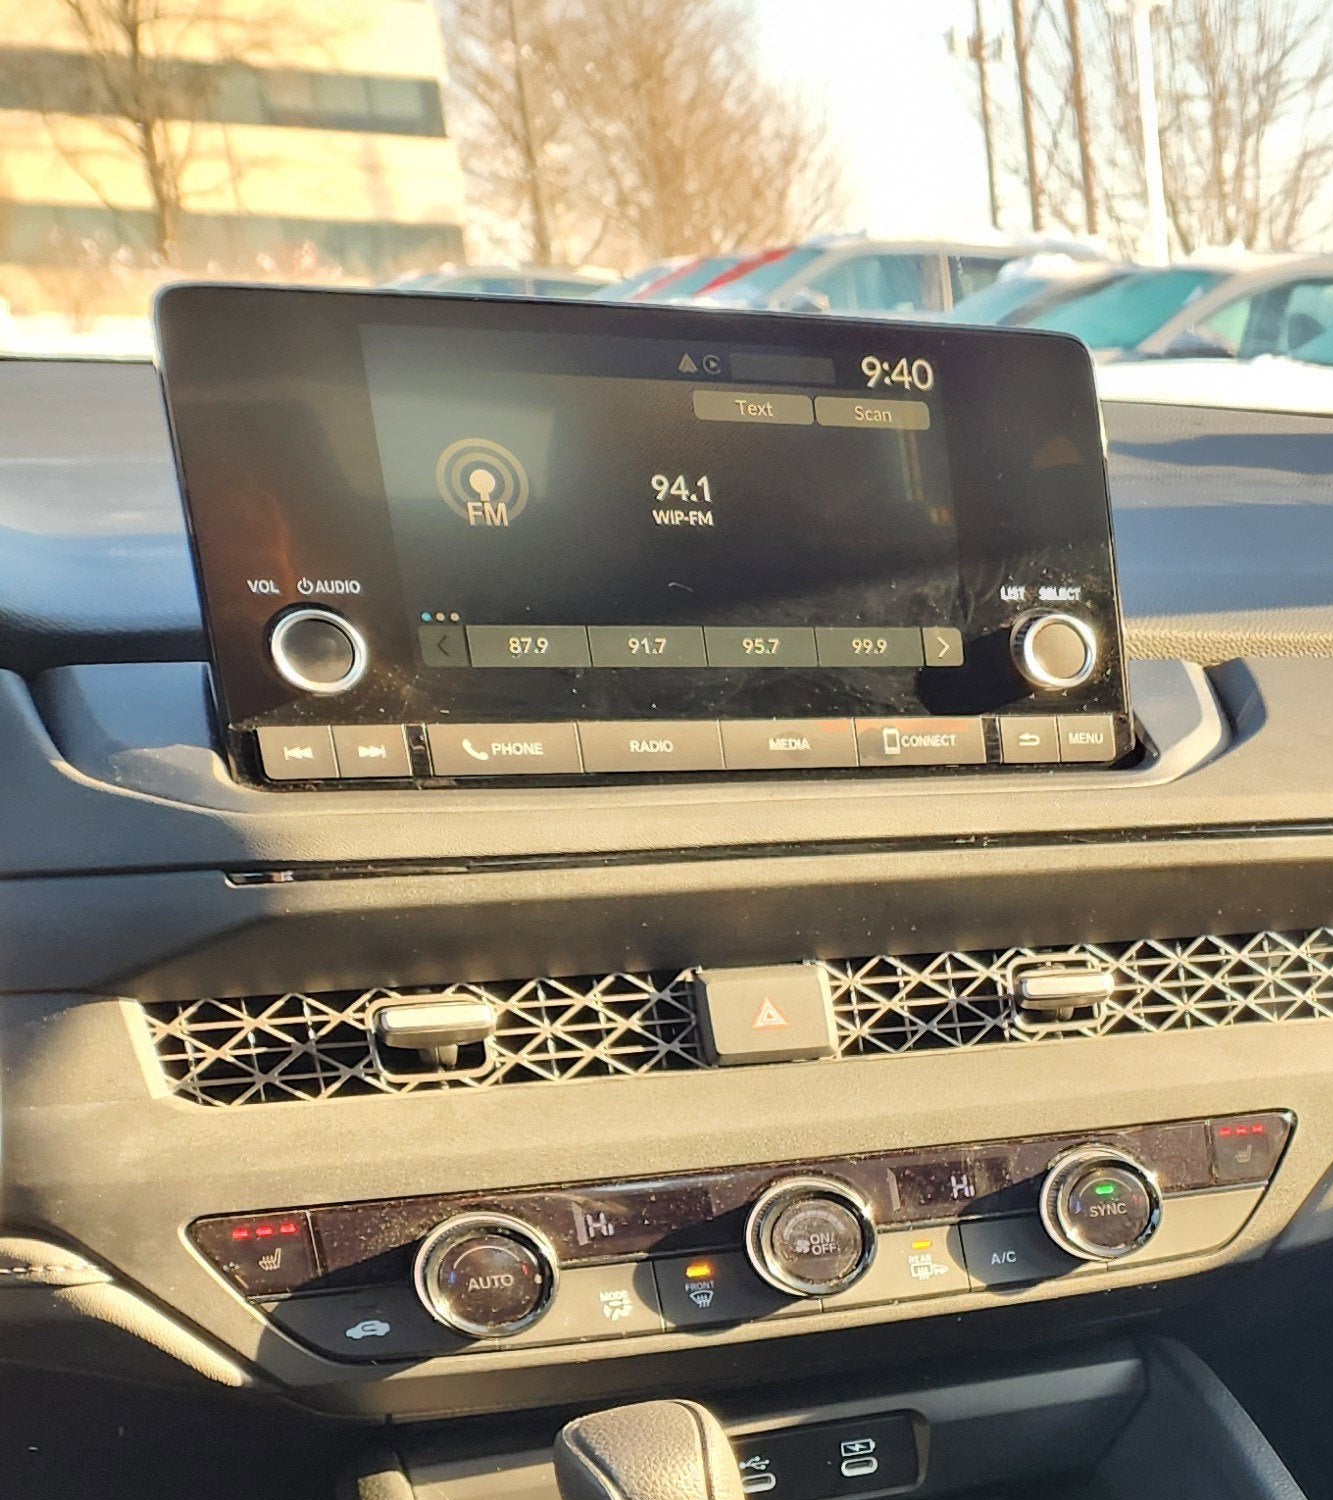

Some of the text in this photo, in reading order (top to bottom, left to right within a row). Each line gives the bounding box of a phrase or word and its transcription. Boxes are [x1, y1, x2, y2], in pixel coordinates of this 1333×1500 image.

[861, 356, 934, 391] 9:40
[735, 400, 774, 418] Text
[854, 405, 893, 423] Scan
[651, 474, 712, 502] 94.1
[467, 502, 509, 527] FM
[652, 509, 714, 526] WIP-FM
[247, 579, 280, 594] VOL
[315, 579, 362, 594] AUDIO
[508, 636, 549, 655] 87.9
[627, 637, 667, 655] 91.7
[742, 637, 780, 655] 95.7
[851, 637, 888, 655] 99.9
[629, 739, 674, 754] RADIO
[768, 737, 811, 752] MEDIA
[900, 733, 957, 748] CONNECT
[1068, 731, 1104, 746] MENU
[490, 740, 544, 757] PHONE
[1089, 1201, 1128, 1218] SYNC
[810, 1232, 836, 1246] ON/
[812, 1241, 838, 1256] OFF
[990, 1249, 1017, 1265] A/C
[908, 1255, 933, 1265] REAR
[467, 1272, 515, 1290] AUTO
[685, 1280, 715, 1291] FRONT
[599, 1289, 630, 1302] MODE
